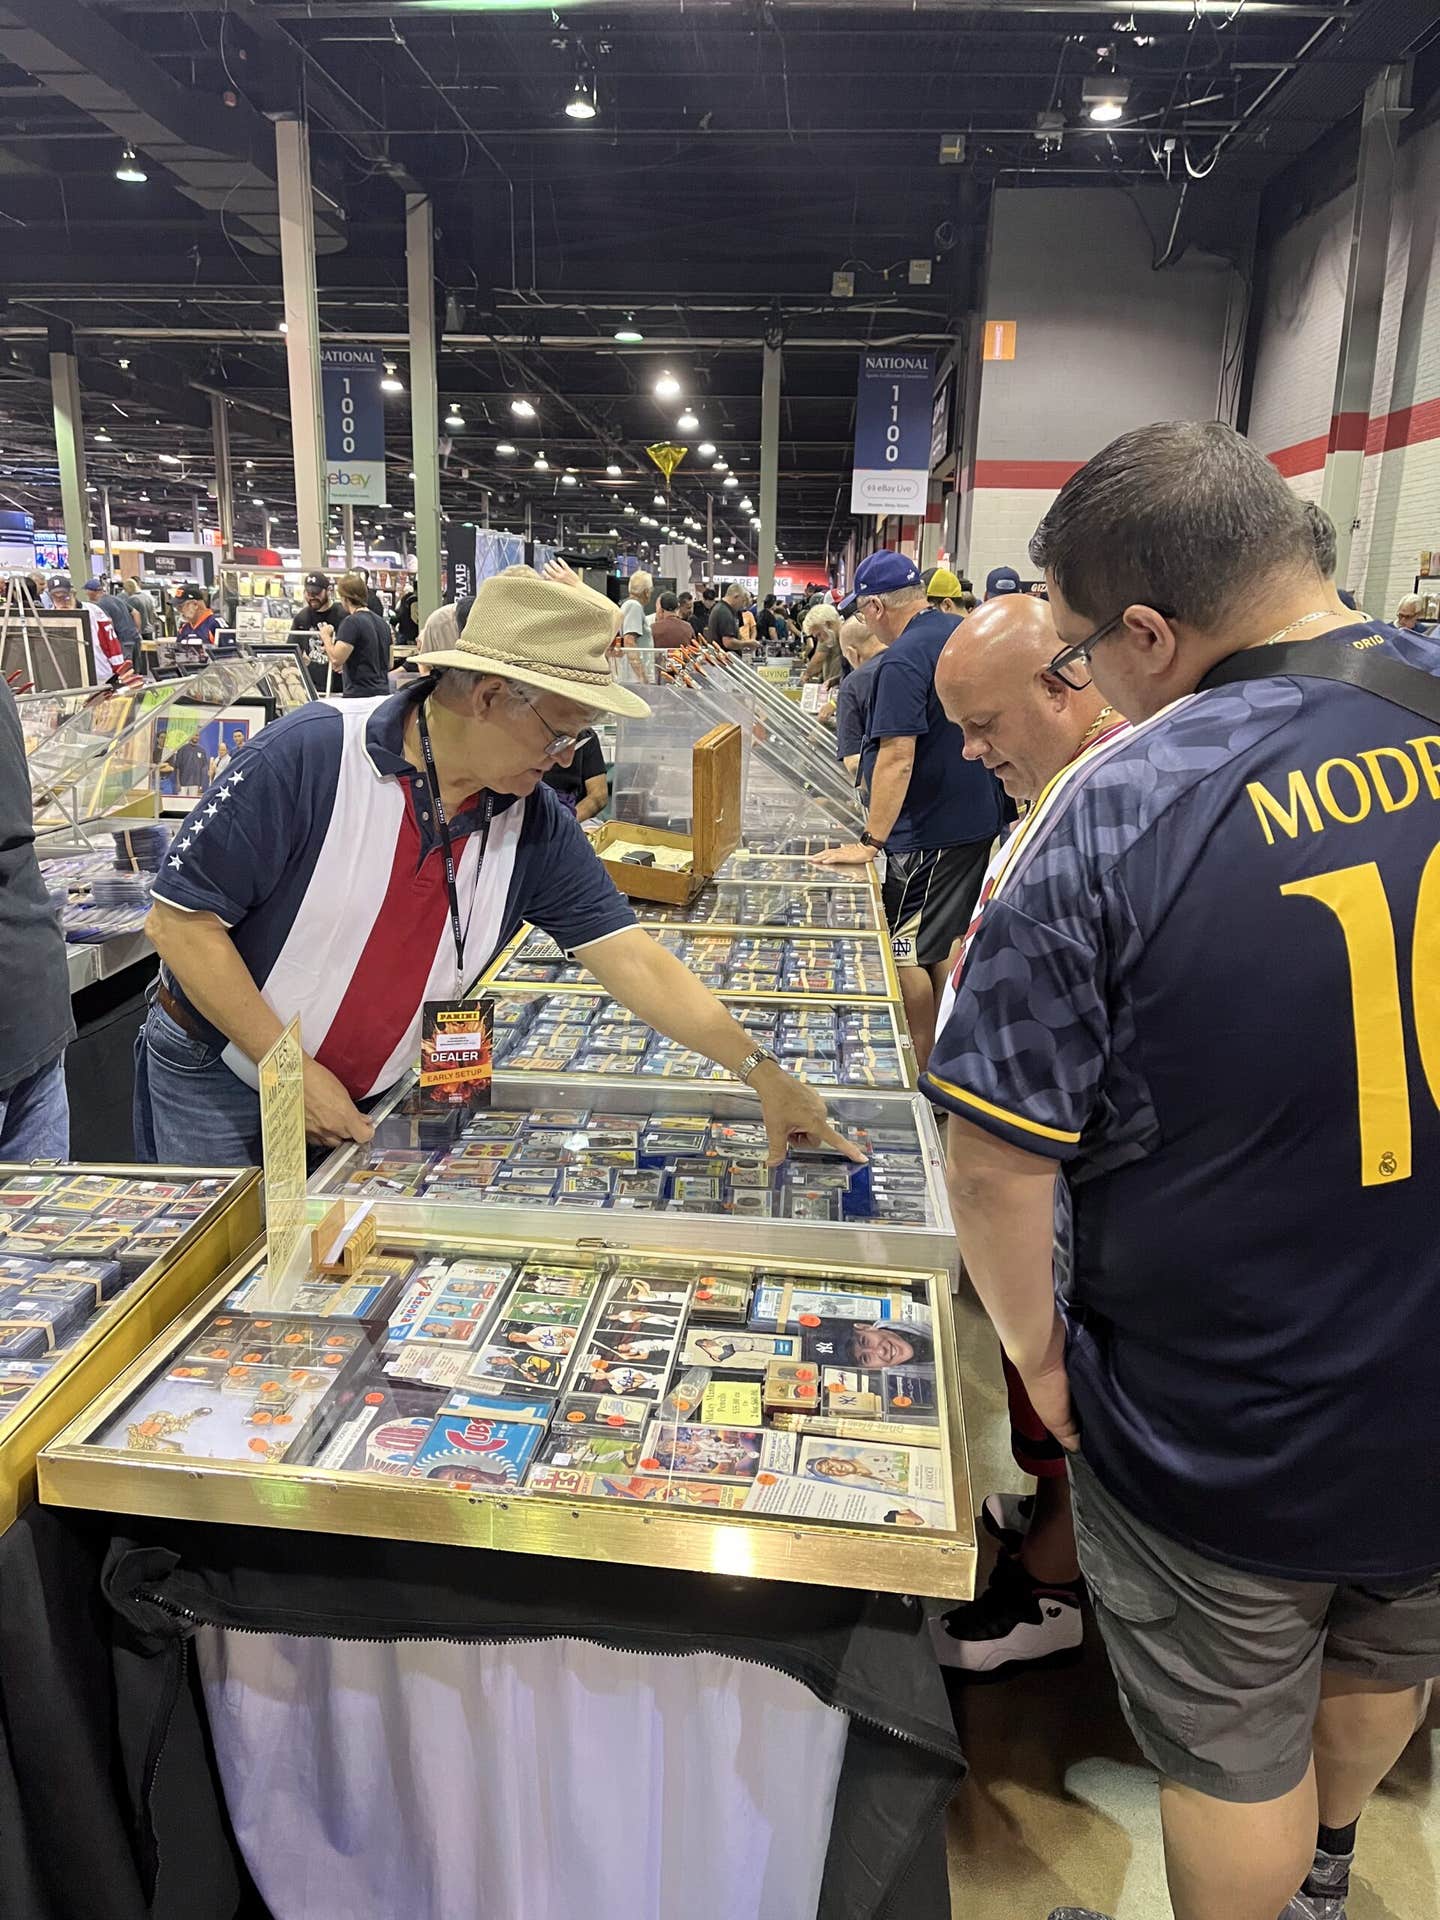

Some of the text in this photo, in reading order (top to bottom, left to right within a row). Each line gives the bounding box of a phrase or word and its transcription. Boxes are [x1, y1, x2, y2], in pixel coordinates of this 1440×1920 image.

[320, 351, 376, 363] NATIONAL
[865, 357, 929, 370] NATIONAL
[341, 378, 355, 453] 1000
[885, 384, 900, 462] 1100
[328, 468, 371, 488] ebay
[439, 1012, 478, 1020] PANINI
[431, 1051, 479, 1063] DEALER
[427, 1068, 482, 1082] EARLY SETUP
[400, 1291, 432, 1323] Bazooka
